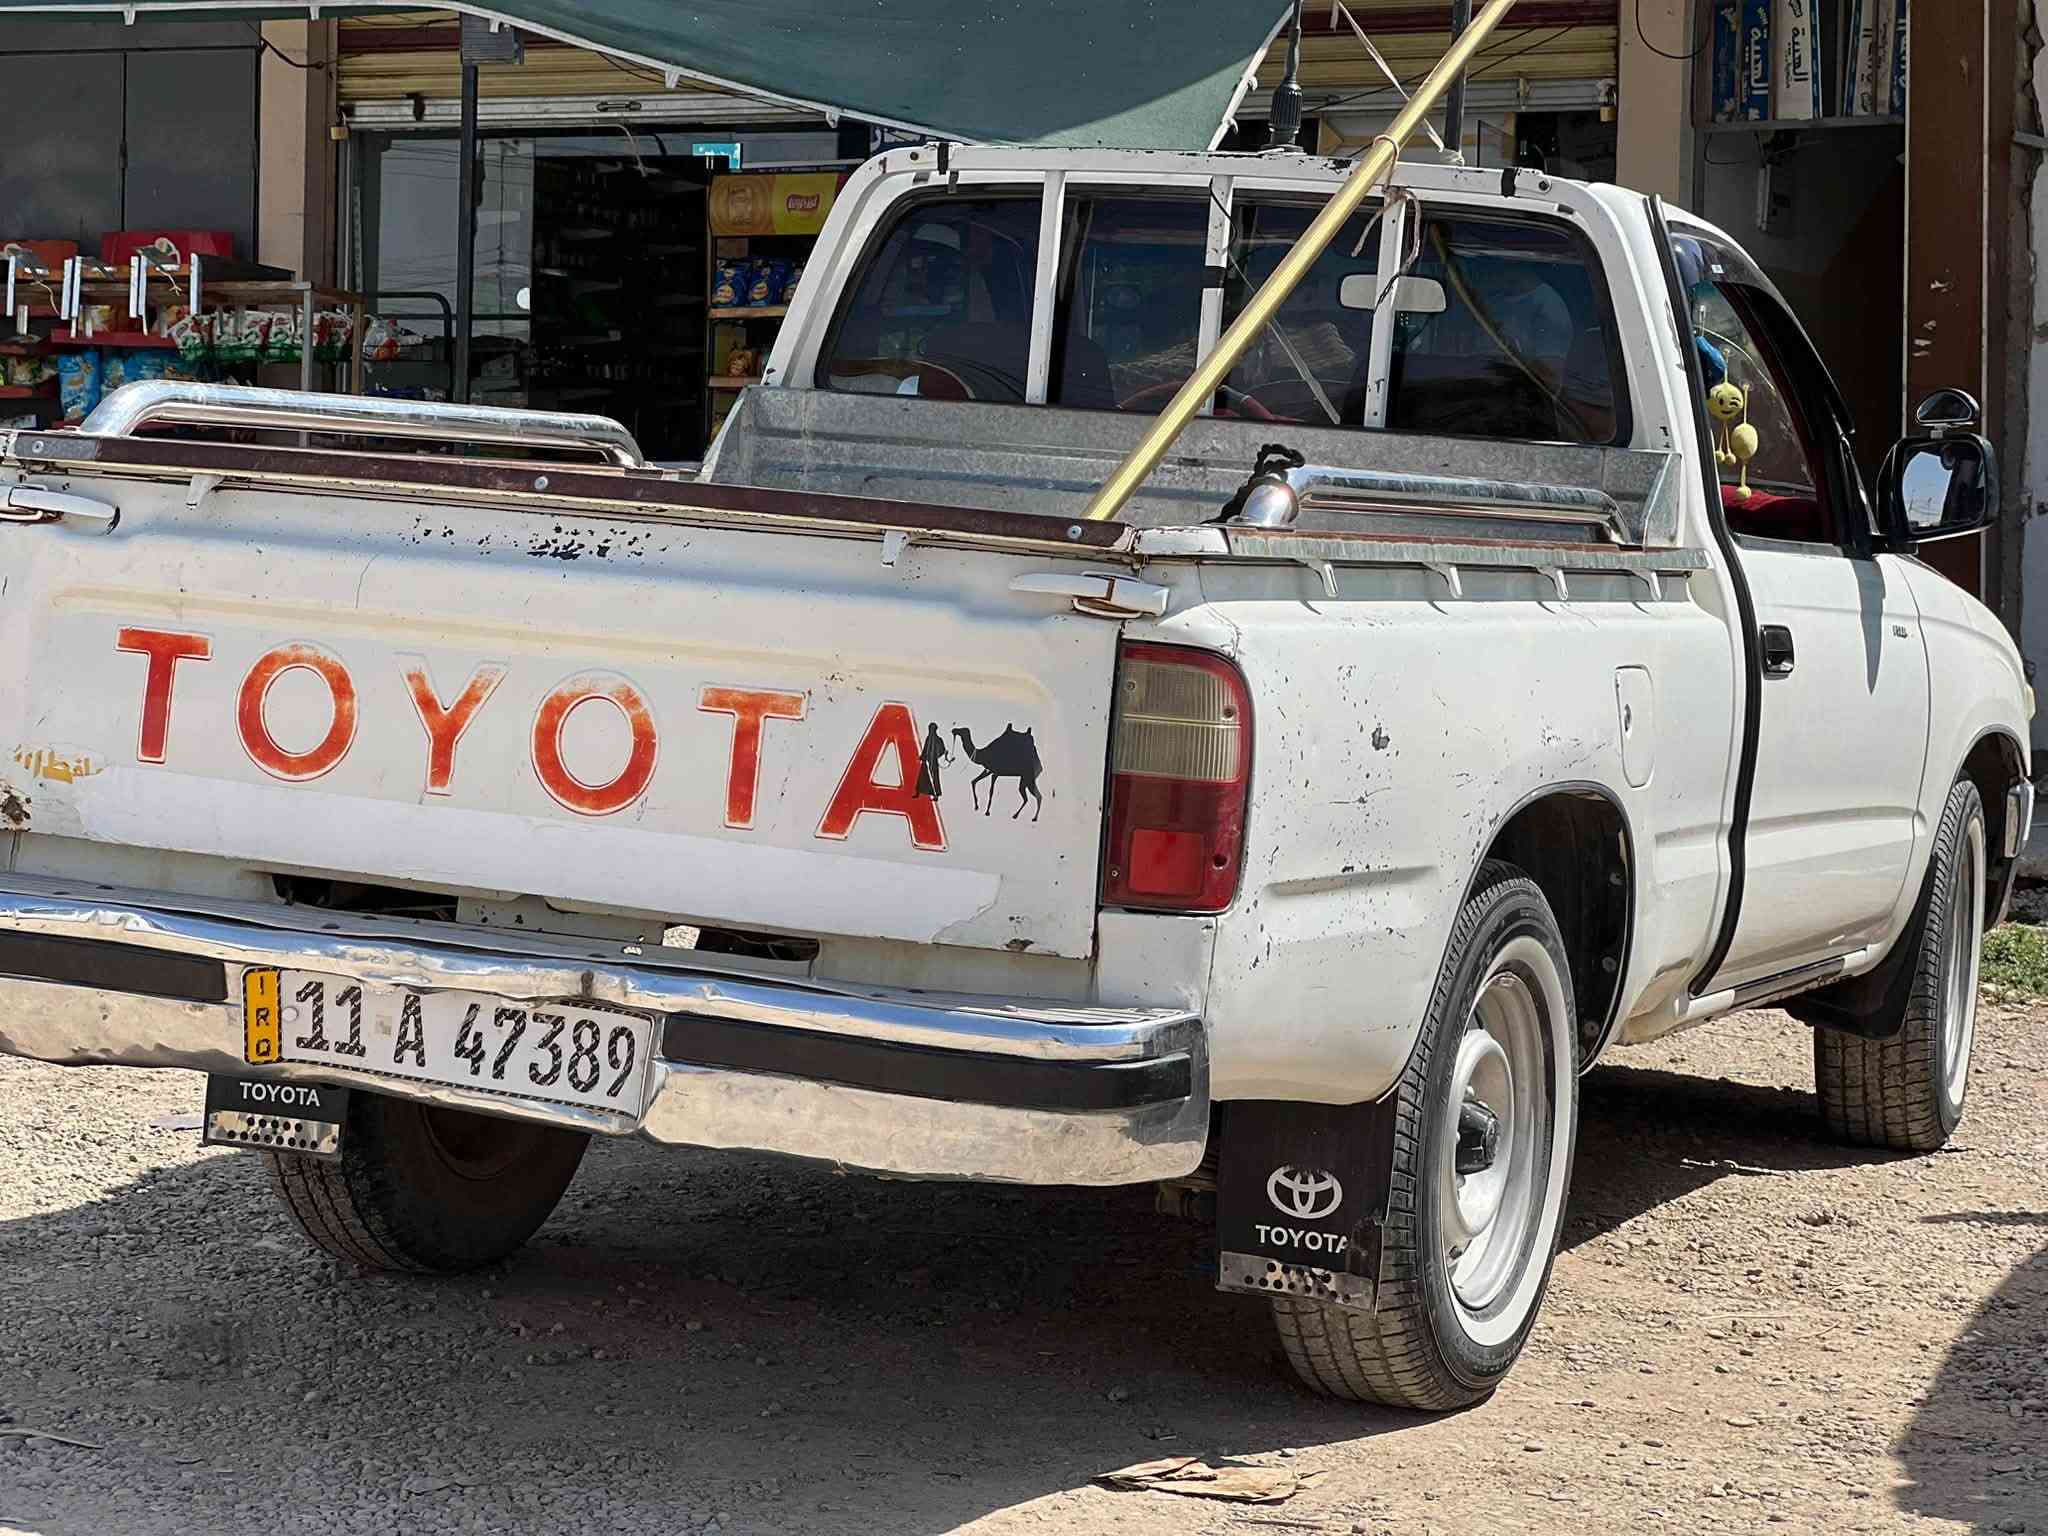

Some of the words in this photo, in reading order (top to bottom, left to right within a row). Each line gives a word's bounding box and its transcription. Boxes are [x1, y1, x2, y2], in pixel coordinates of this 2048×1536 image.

[114, 624, 949, 852] TOYOTA
[256, 976, 272, 1057] IRQ
[295, 981, 367, 1058] 11
[394, 993, 426, 1067] A
[454, 1003, 637, 1098] 47389
[239, 1081, 321, 1108] TOYOTA
